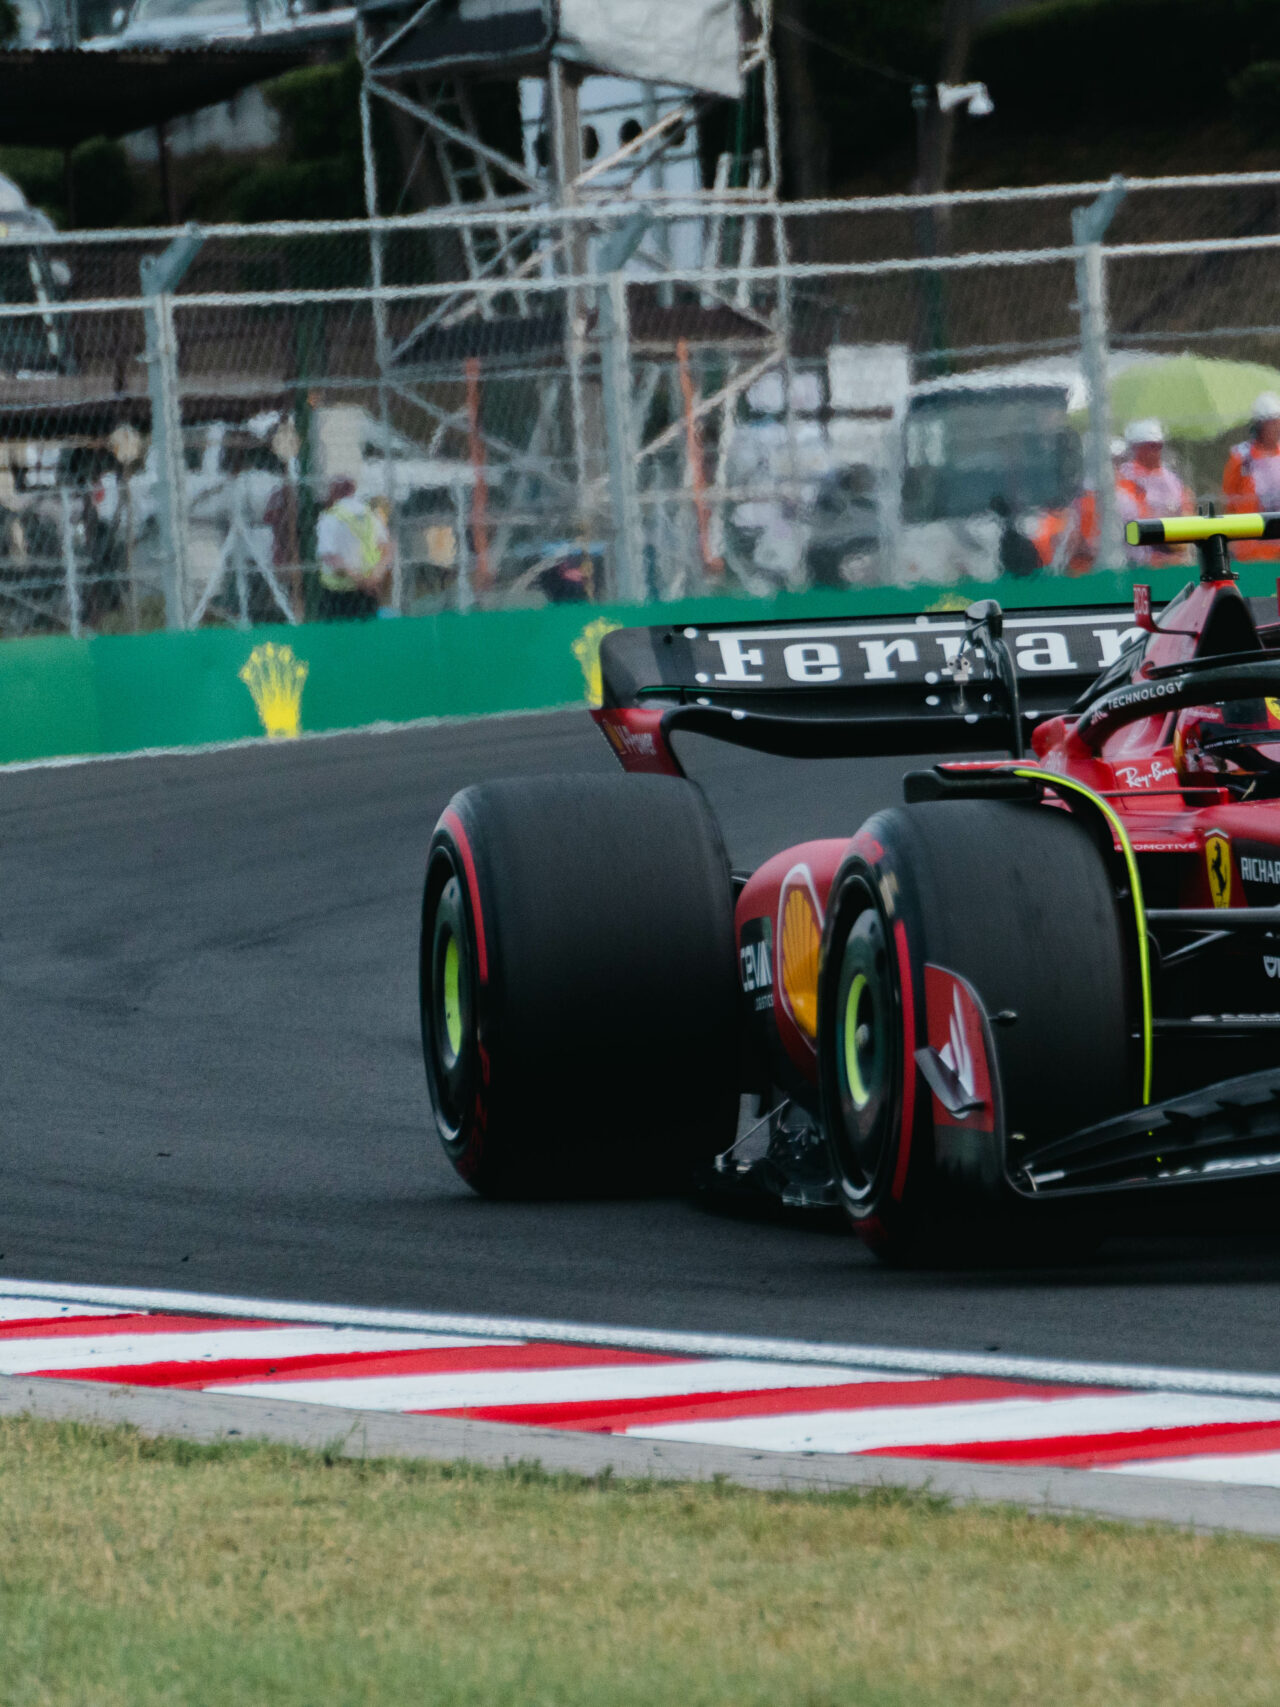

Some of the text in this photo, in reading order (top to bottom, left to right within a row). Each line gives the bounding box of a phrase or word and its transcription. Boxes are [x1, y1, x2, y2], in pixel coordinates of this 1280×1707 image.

[708, 614, 1152, 682] Ferrar
[1106, 681, 1184, 710] TECHNOLOGY
[1115, 761, 1177, 787] Ray-Ban
